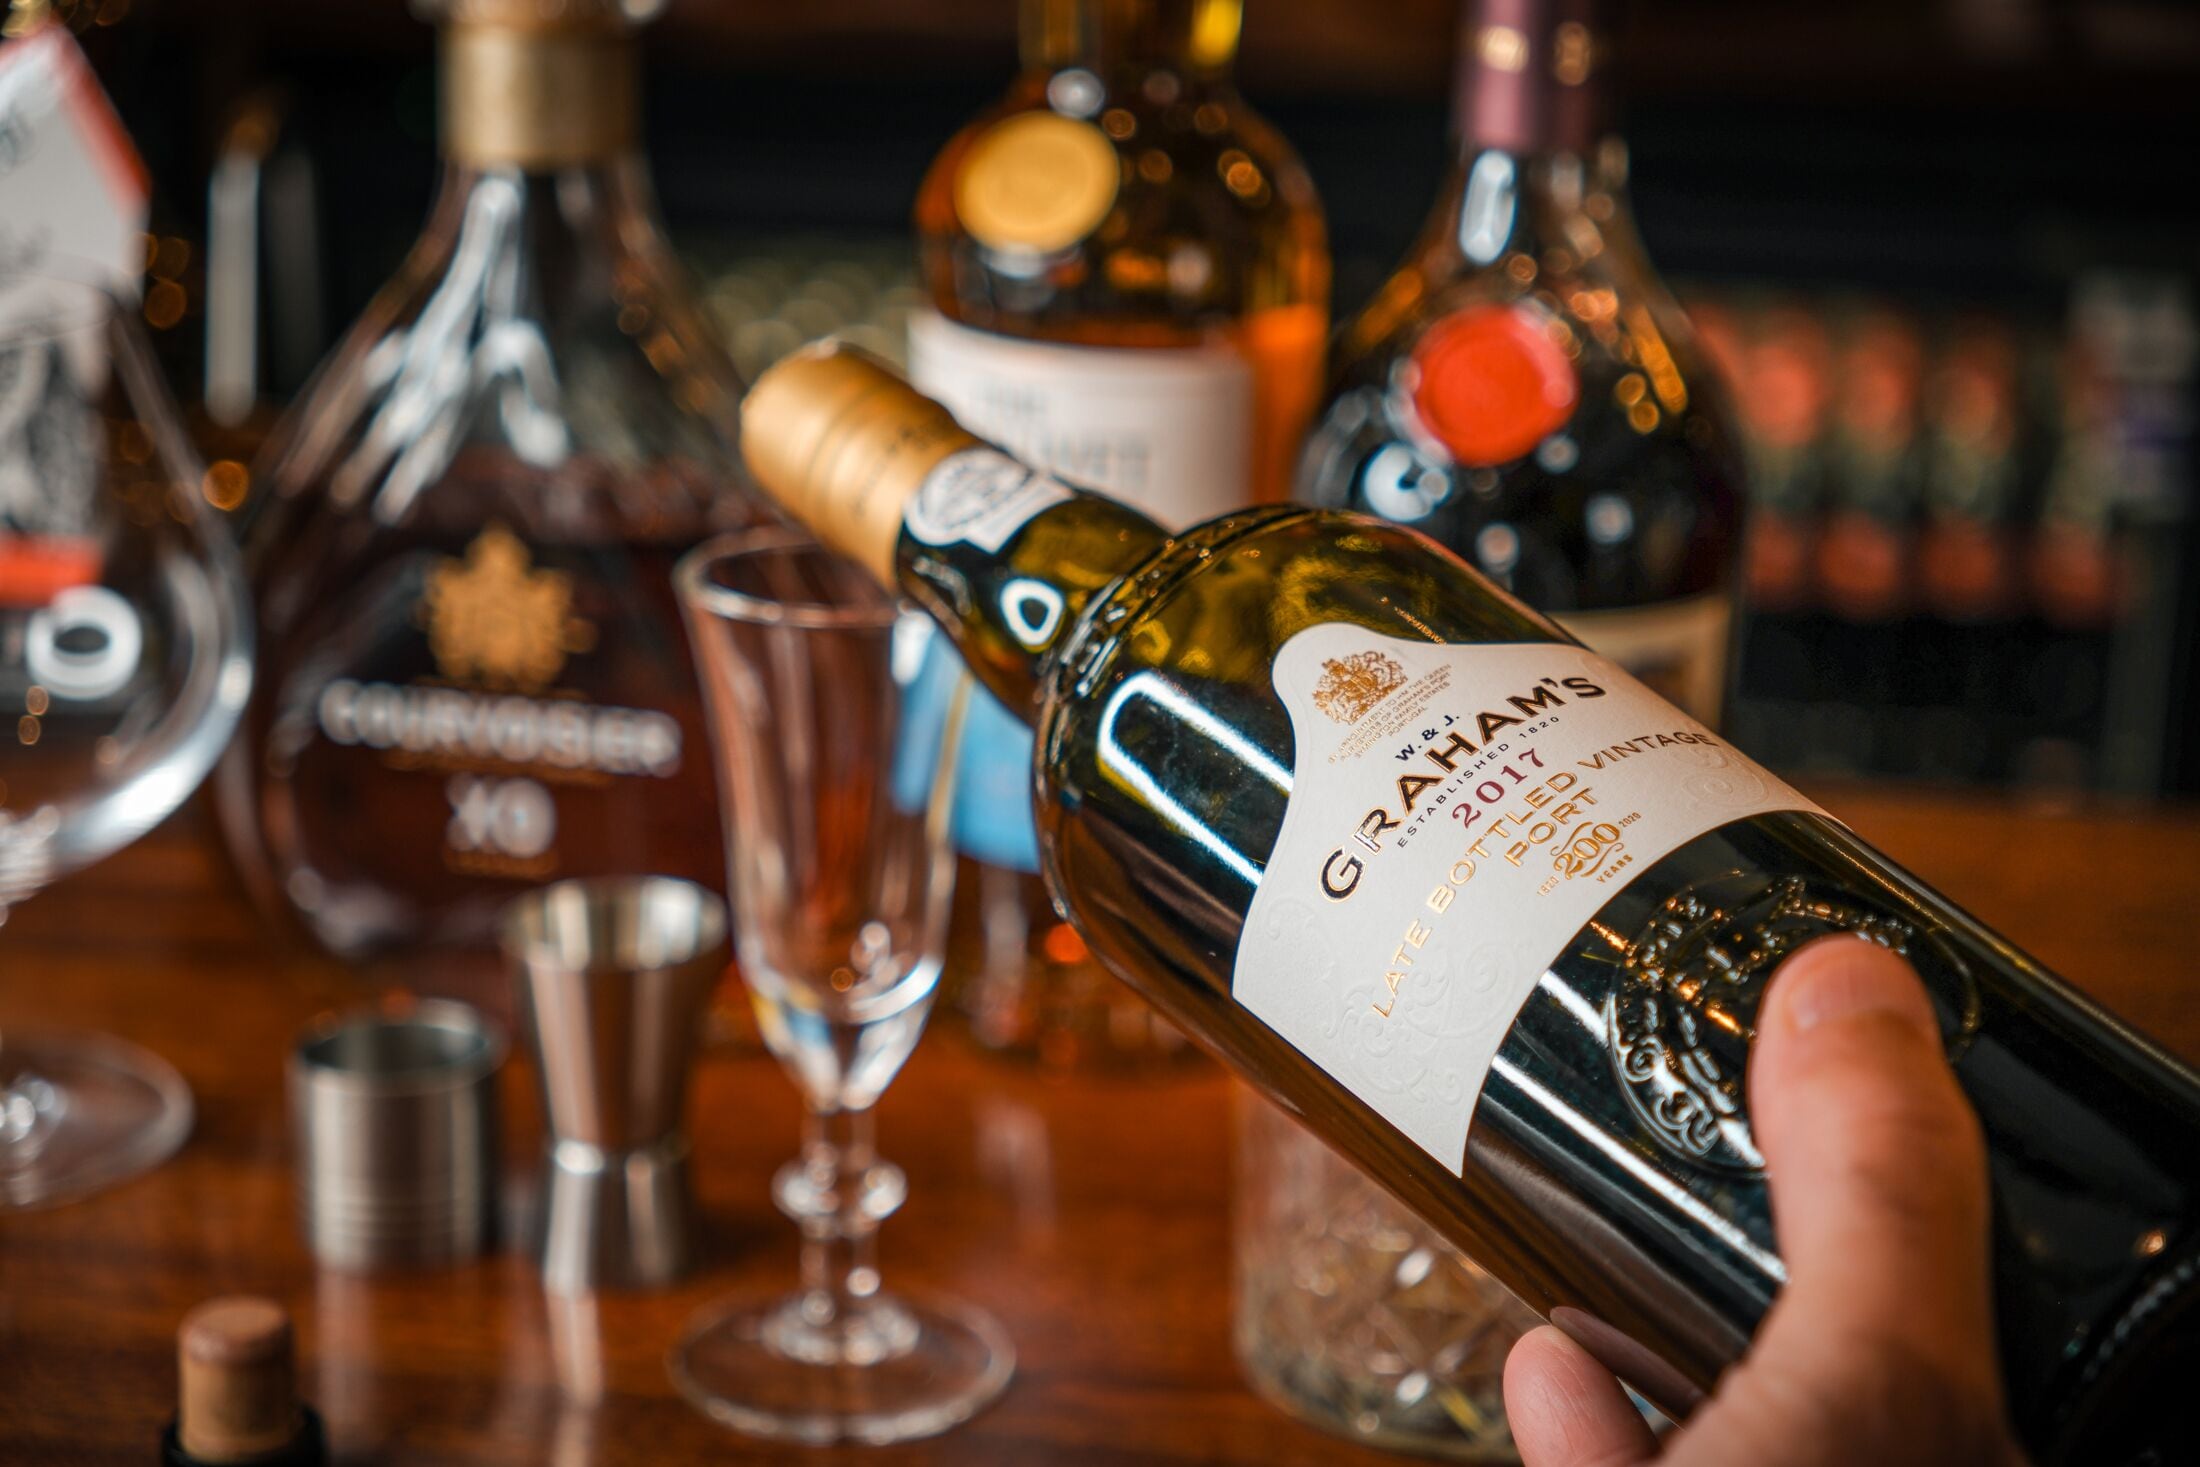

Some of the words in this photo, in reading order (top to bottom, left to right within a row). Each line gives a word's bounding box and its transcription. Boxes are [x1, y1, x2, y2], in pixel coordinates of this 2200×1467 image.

[1385, 698, 1397, 708] TO
[1409, 678, 1424, 690] THE
[1423, 663, 1451, 682] QUEEN
[1394, 701, 1419, 721] FAMILY
[1418, 680, 1449, 702] ESTATES
[1380, 710, 1392, 723] OF
[1387, 705, 1427, 737] PORTUGAL
[1395, 744, 1422, 762] W.
[1421, 728, 1439, 741] &
[1443, 714, 1460, 727] J.
[1319, 677, 1606, 902] GRAHAM'S
[1397, 743, 1509, 848] ESTABLISHED
[1518, 716, 1560, 739] 1820
[1452, 747, 1545, 829] 2017
[1504, 787, 1598, 867] PORT
[1553, 823, 1620, 880] 200
[1618, 812, 1642, 828] 2020
[1372, 918, 1432, 1019] LATE
[1427, 772, 1578, 914] BOTTLED
[1577, 731, 1720, 770] VINTAGE
[1596, 854, 1633, 883] YEARS
